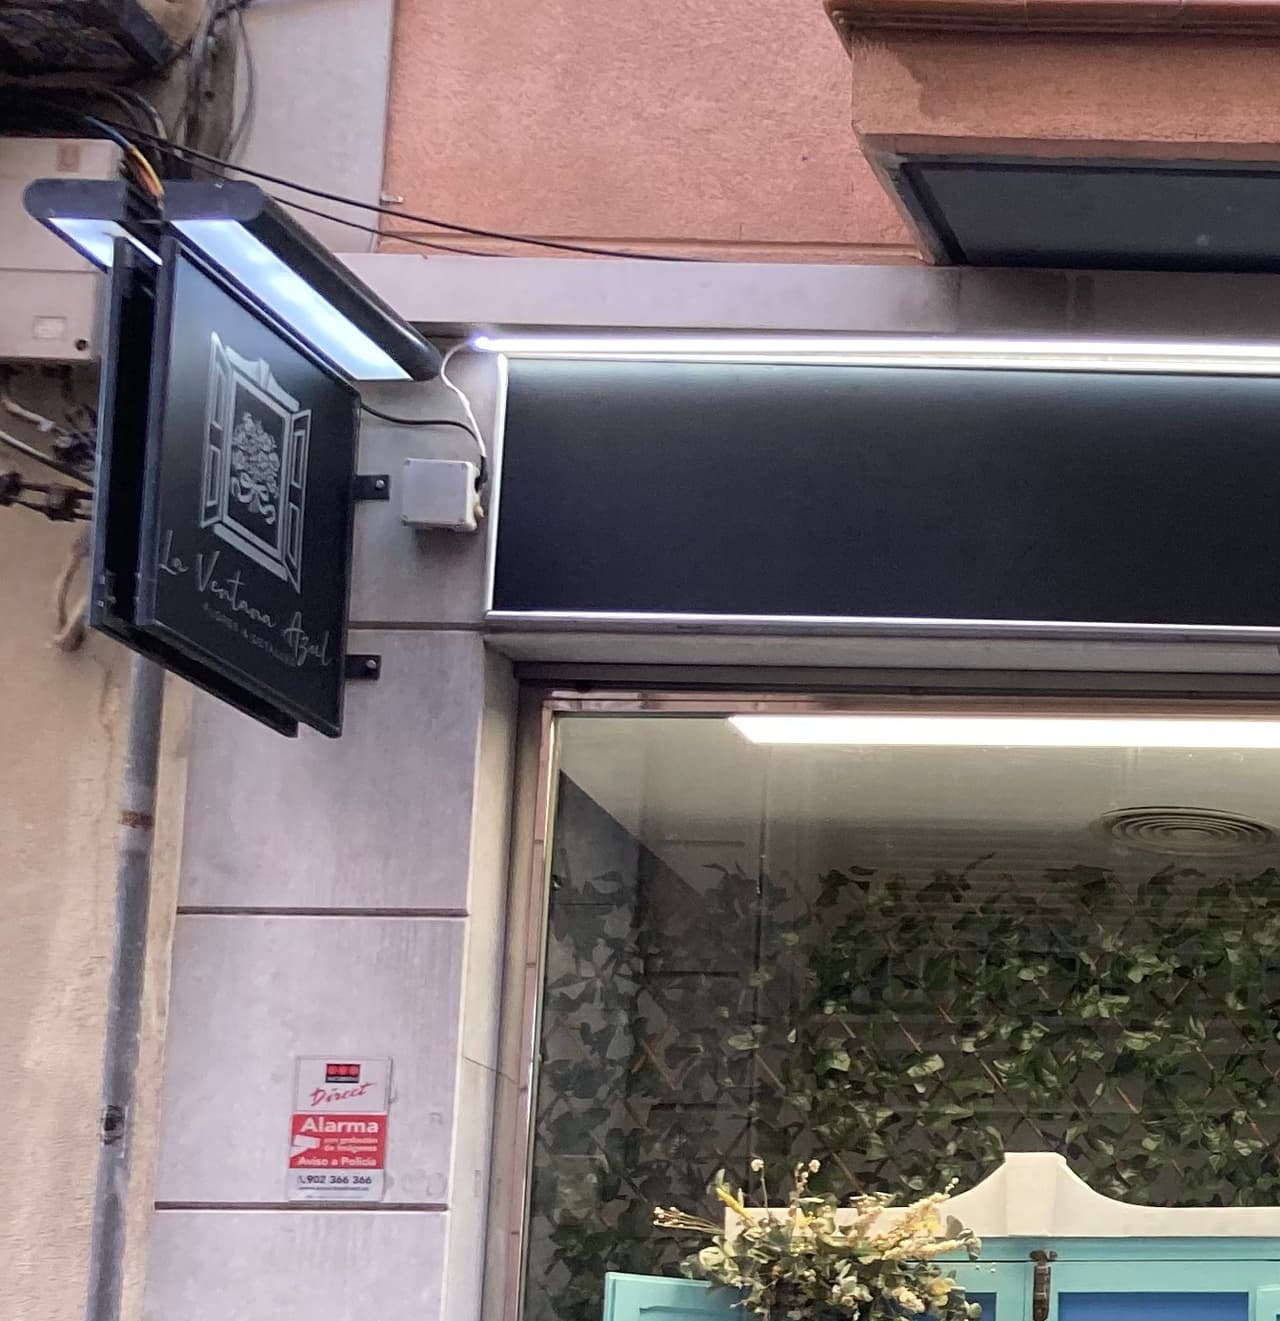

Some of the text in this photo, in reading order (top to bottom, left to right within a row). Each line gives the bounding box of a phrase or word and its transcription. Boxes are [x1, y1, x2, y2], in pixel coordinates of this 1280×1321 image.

[158, 529, 190, 576] La
[198, 551, 277, 629] Ventana
[283, 610, 332, 666] Azul
[300, 1116, 379, 1134] Alarma
